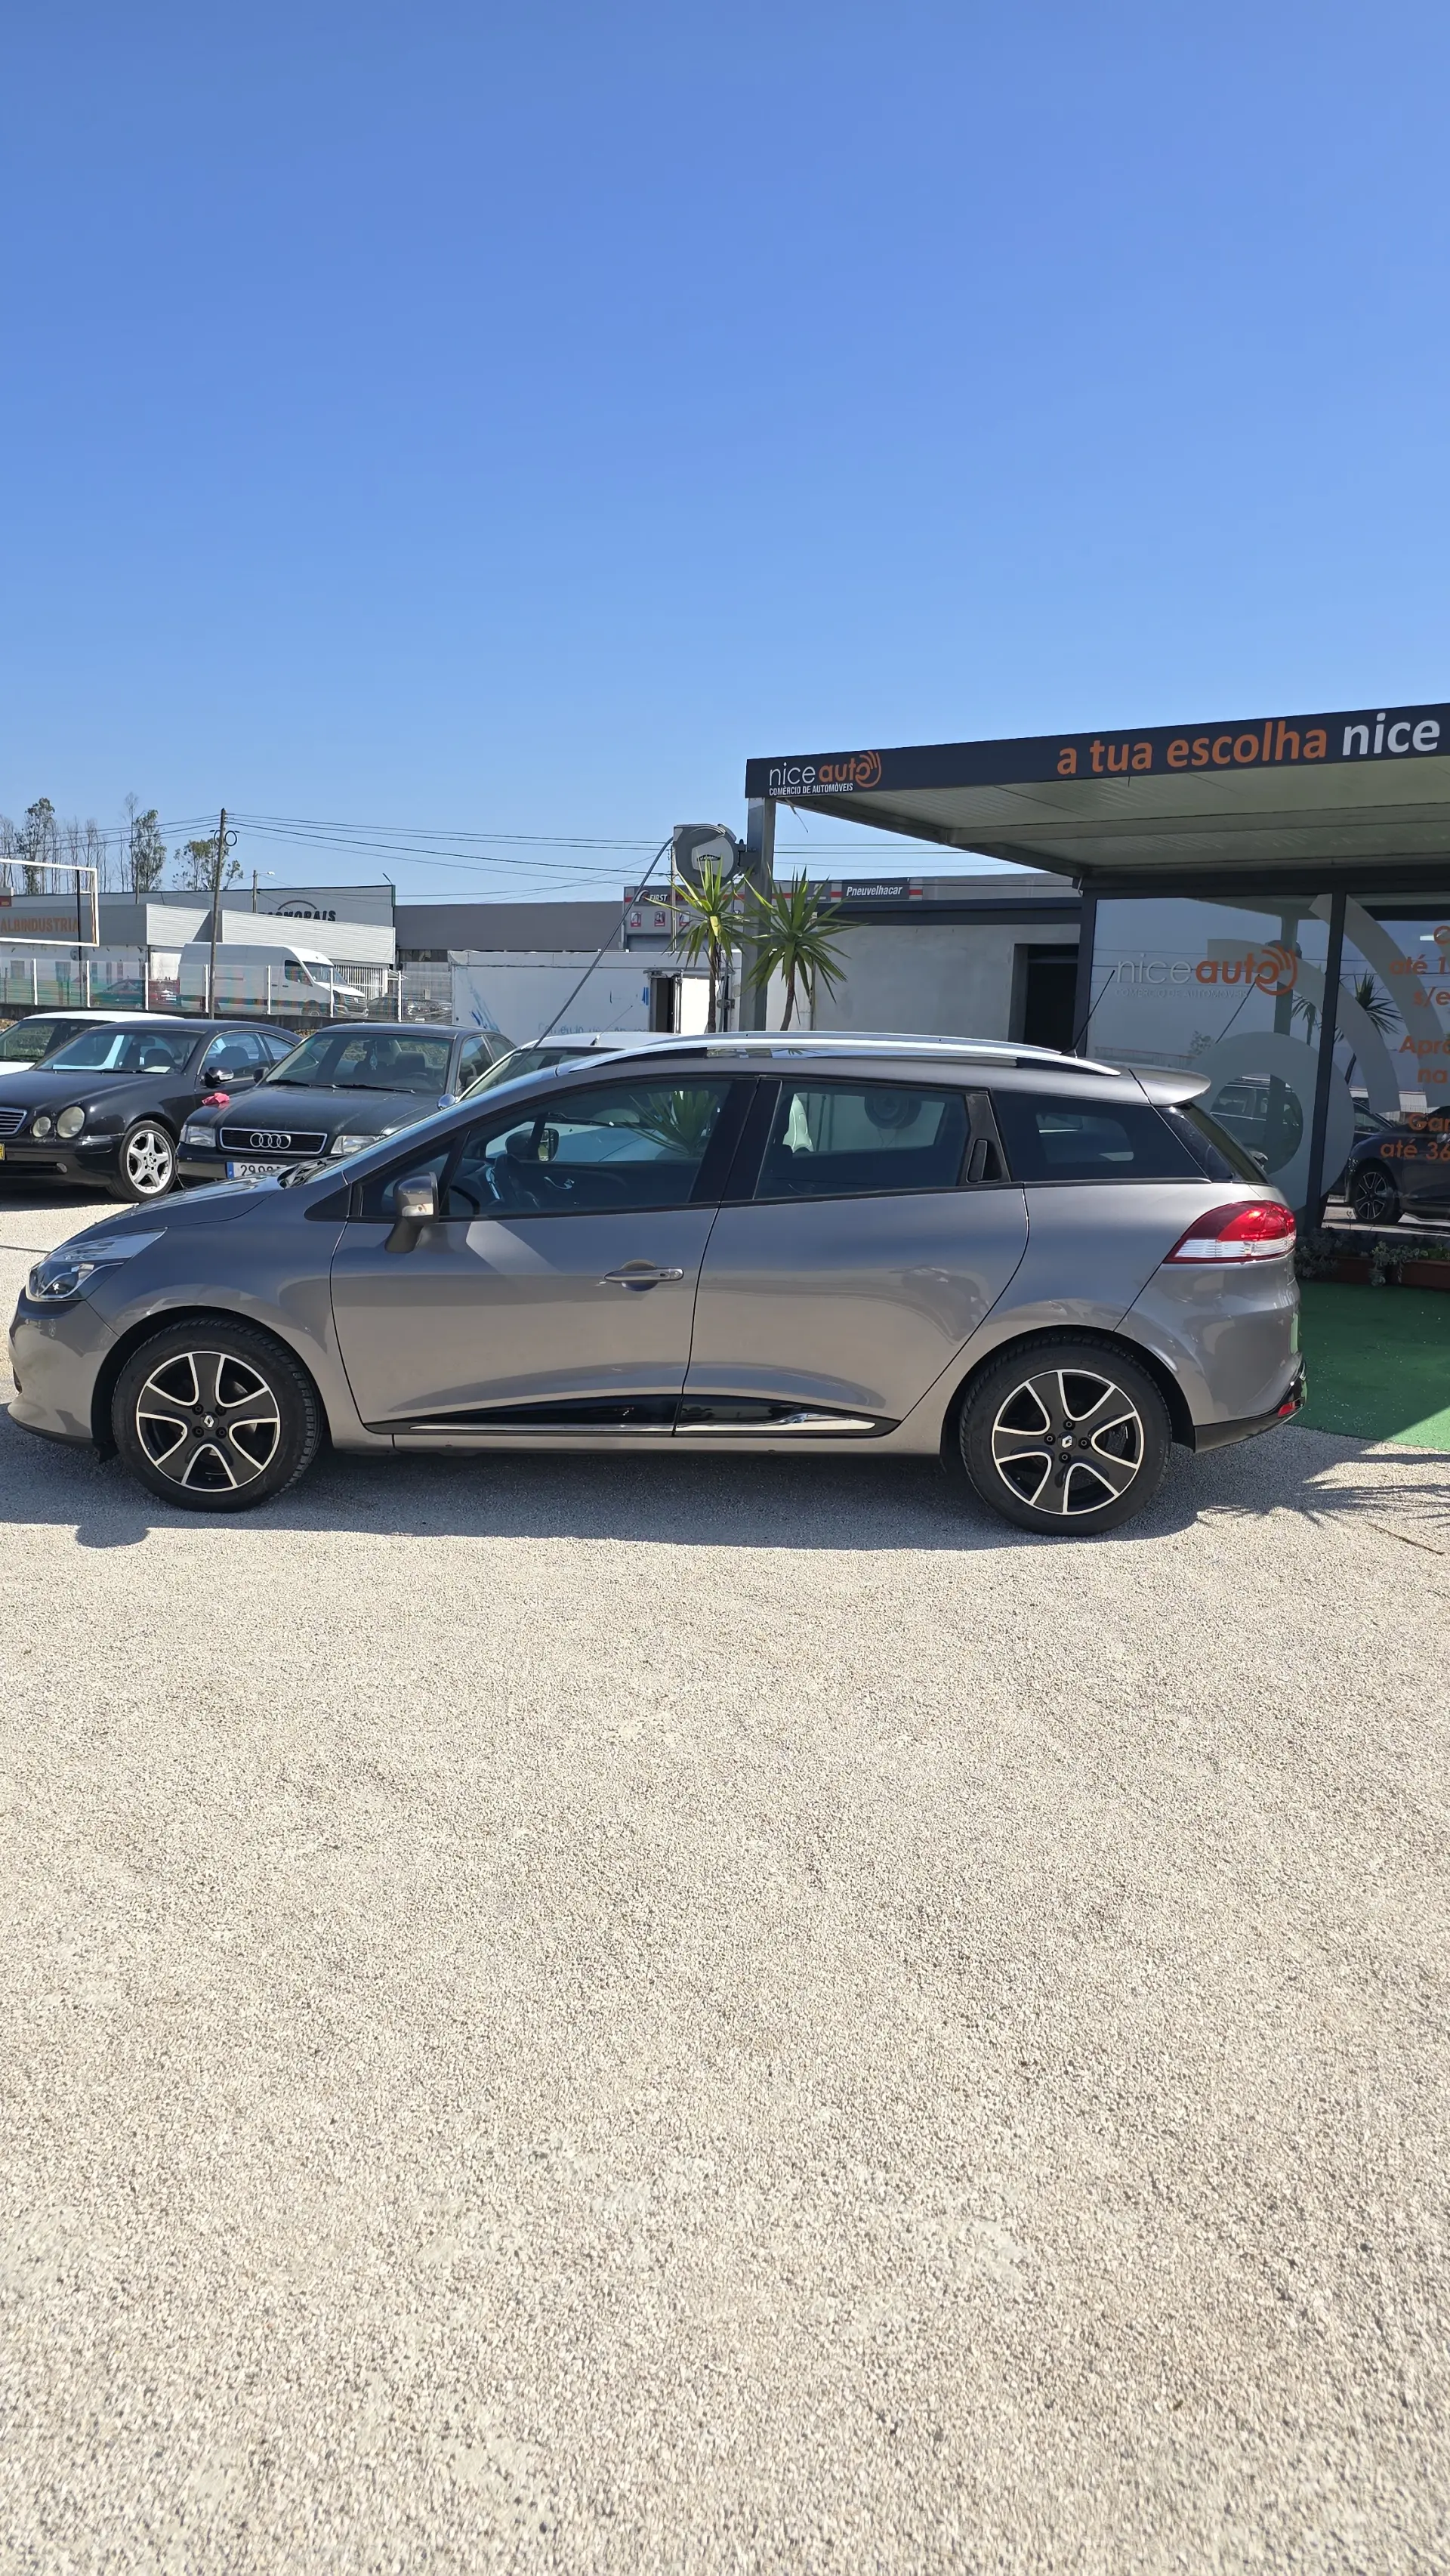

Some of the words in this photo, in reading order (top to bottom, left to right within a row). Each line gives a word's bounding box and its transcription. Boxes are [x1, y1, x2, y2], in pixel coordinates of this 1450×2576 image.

[1057, 747, 1077, 775] a
[1090, 740, 1152, 773] tua
[1166, 721, 1327, 768] escolha
[1342, 712, 1440, 755] nice
[769, 761, 816, 786] nice
[819, 751, 881, 788] auto
[802, 786, 811, 794] DE
[649, 894, 668, 902] FIRST
[846, 885, 903, 897] Pneuvelhacar
[1116, 953, 1192, 984] nice
[1195, 944, 1298, 996] auto
[1389, 953, 1428, 975] até
[1418, 1068, 1448, 1084] na
[1380, 1138, 1418, 1159] até
